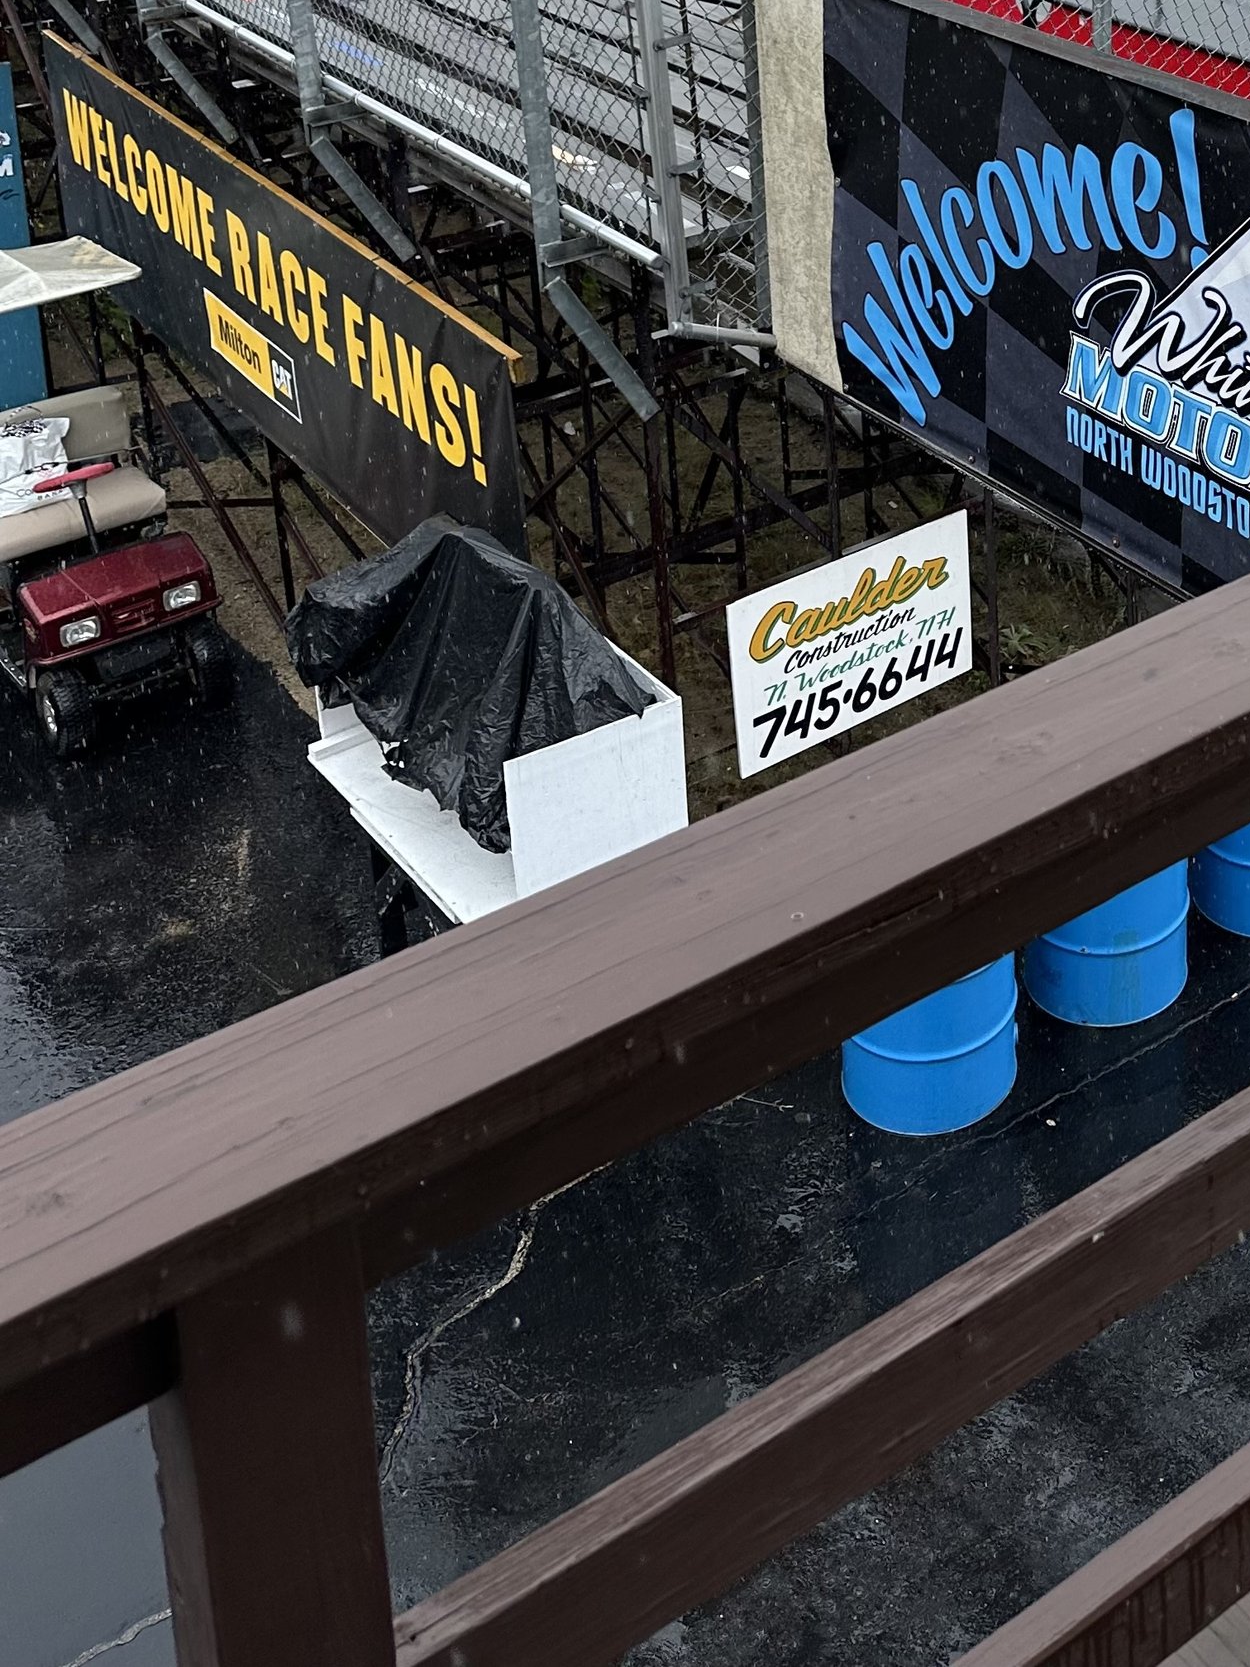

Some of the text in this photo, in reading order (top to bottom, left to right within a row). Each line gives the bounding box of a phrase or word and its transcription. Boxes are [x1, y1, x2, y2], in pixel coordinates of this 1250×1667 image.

[62, 87, 488, 488] WELCOME RACE FANS!
[841, 107, 1209, 428] Welcome!
[217, 314, 262, 375] Milton
[271, 359, 293, 401] CAT
[1066, 405, 1135, 476] NORTH
[748, 555, 951, 665] Caulder
[783, 606, 917, 675] Construction
[763, 605, 957, 707] N. Woodstock, NH
